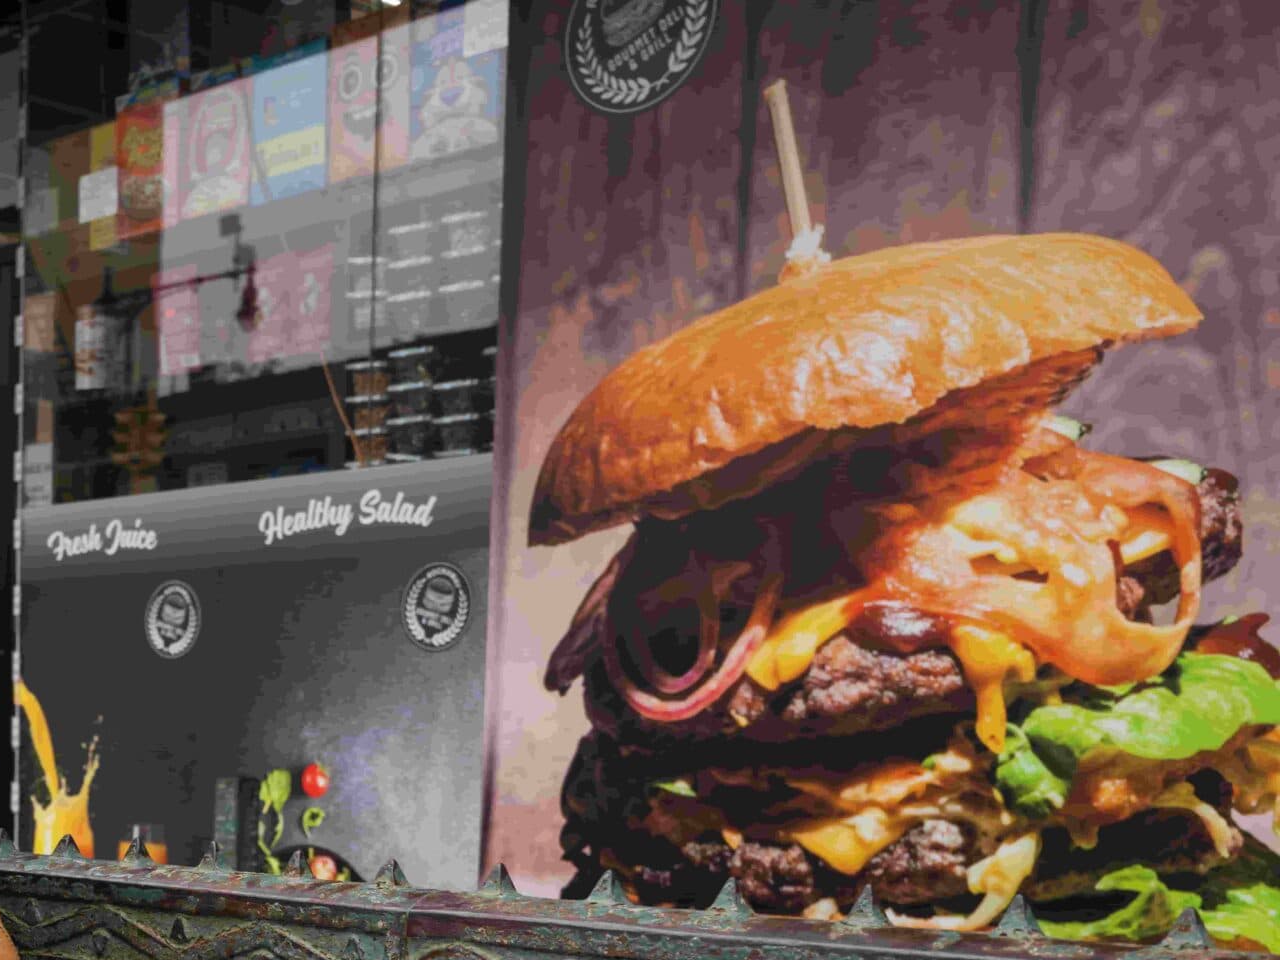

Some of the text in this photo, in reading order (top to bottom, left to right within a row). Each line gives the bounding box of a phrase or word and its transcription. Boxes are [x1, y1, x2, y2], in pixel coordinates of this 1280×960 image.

[607, 6, 684, 72] GOURMET DELI
[640, 33, 673, 61] GRILL
[47, 518, 157, 561] Fresh Juice
[258, 489, 437, 545] Healthy Salad
